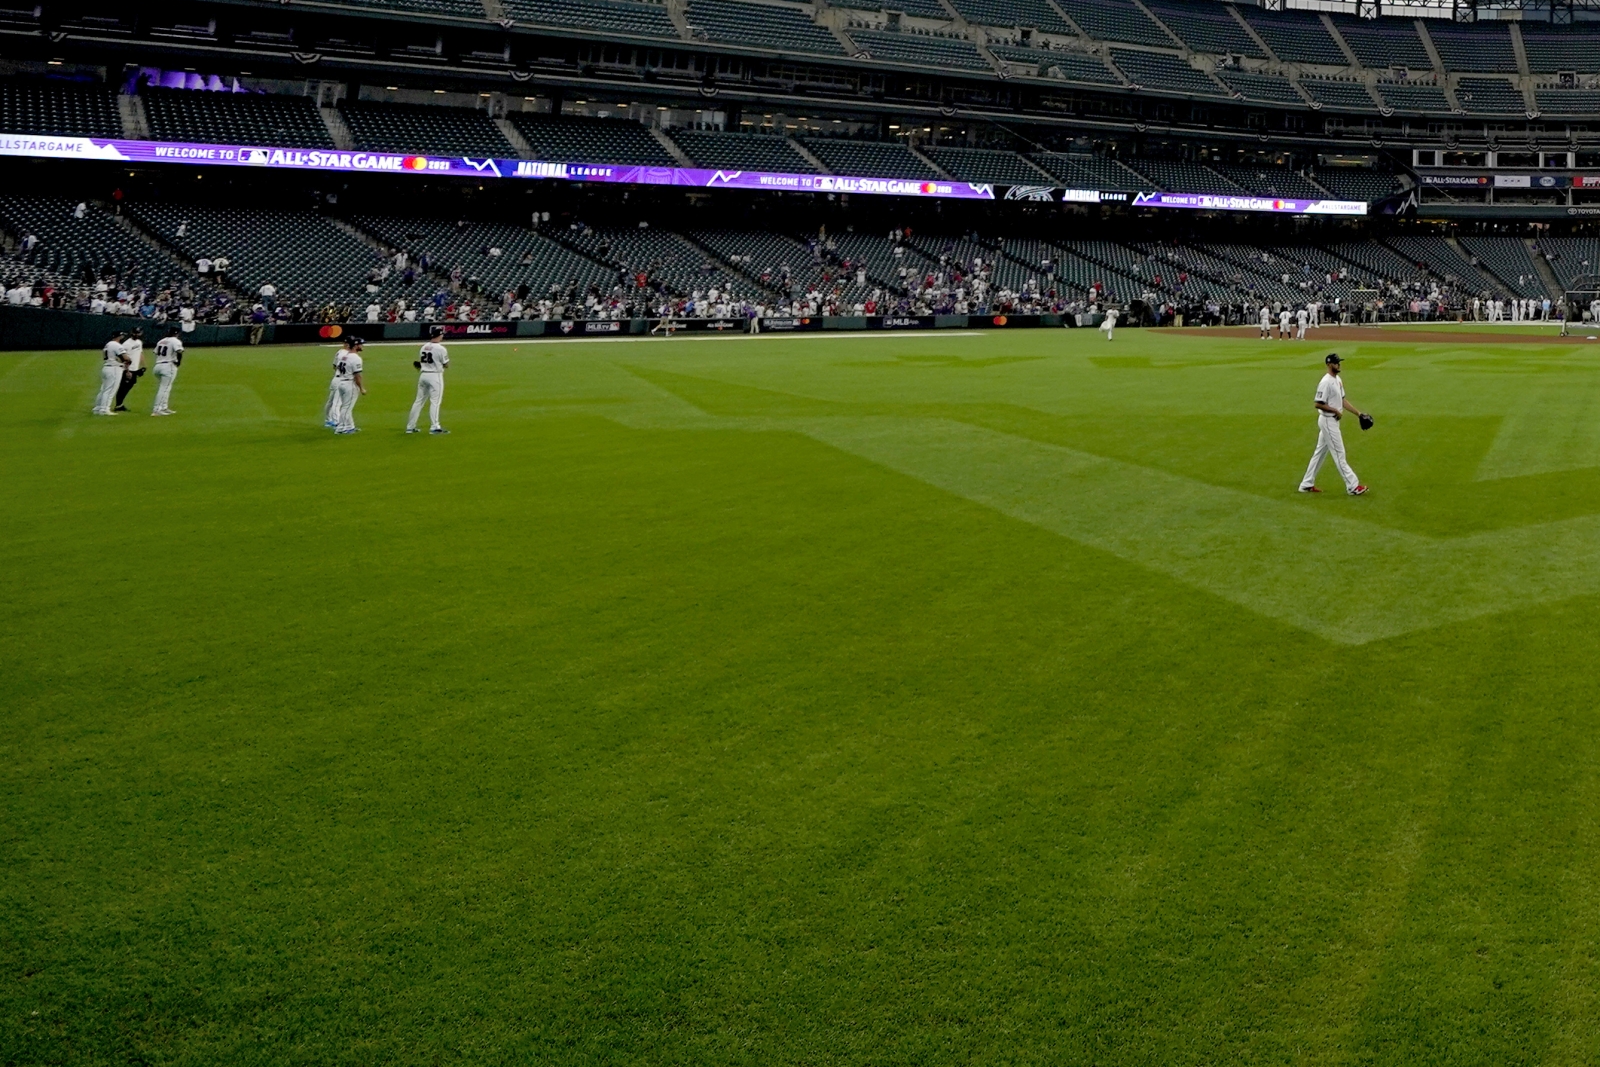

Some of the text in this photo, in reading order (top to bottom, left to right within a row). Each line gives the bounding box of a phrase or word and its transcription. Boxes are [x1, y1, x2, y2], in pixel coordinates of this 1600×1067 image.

[155, 147, 215, 159] WELCOME
[219, 150, 234, 160] TO
[428, 160, 450, 170] 2021
[517, 161, 612, 177] NATIONAL LEAGUE
[760, 176, 798, 186] WELCOME
[801, 178, 812, 187] TO
[1101, 192, 1127, 201] LEAGUE
[1161, 195, 1188, 204] WELCOME
[1189, 197, 1196, 205] TO
